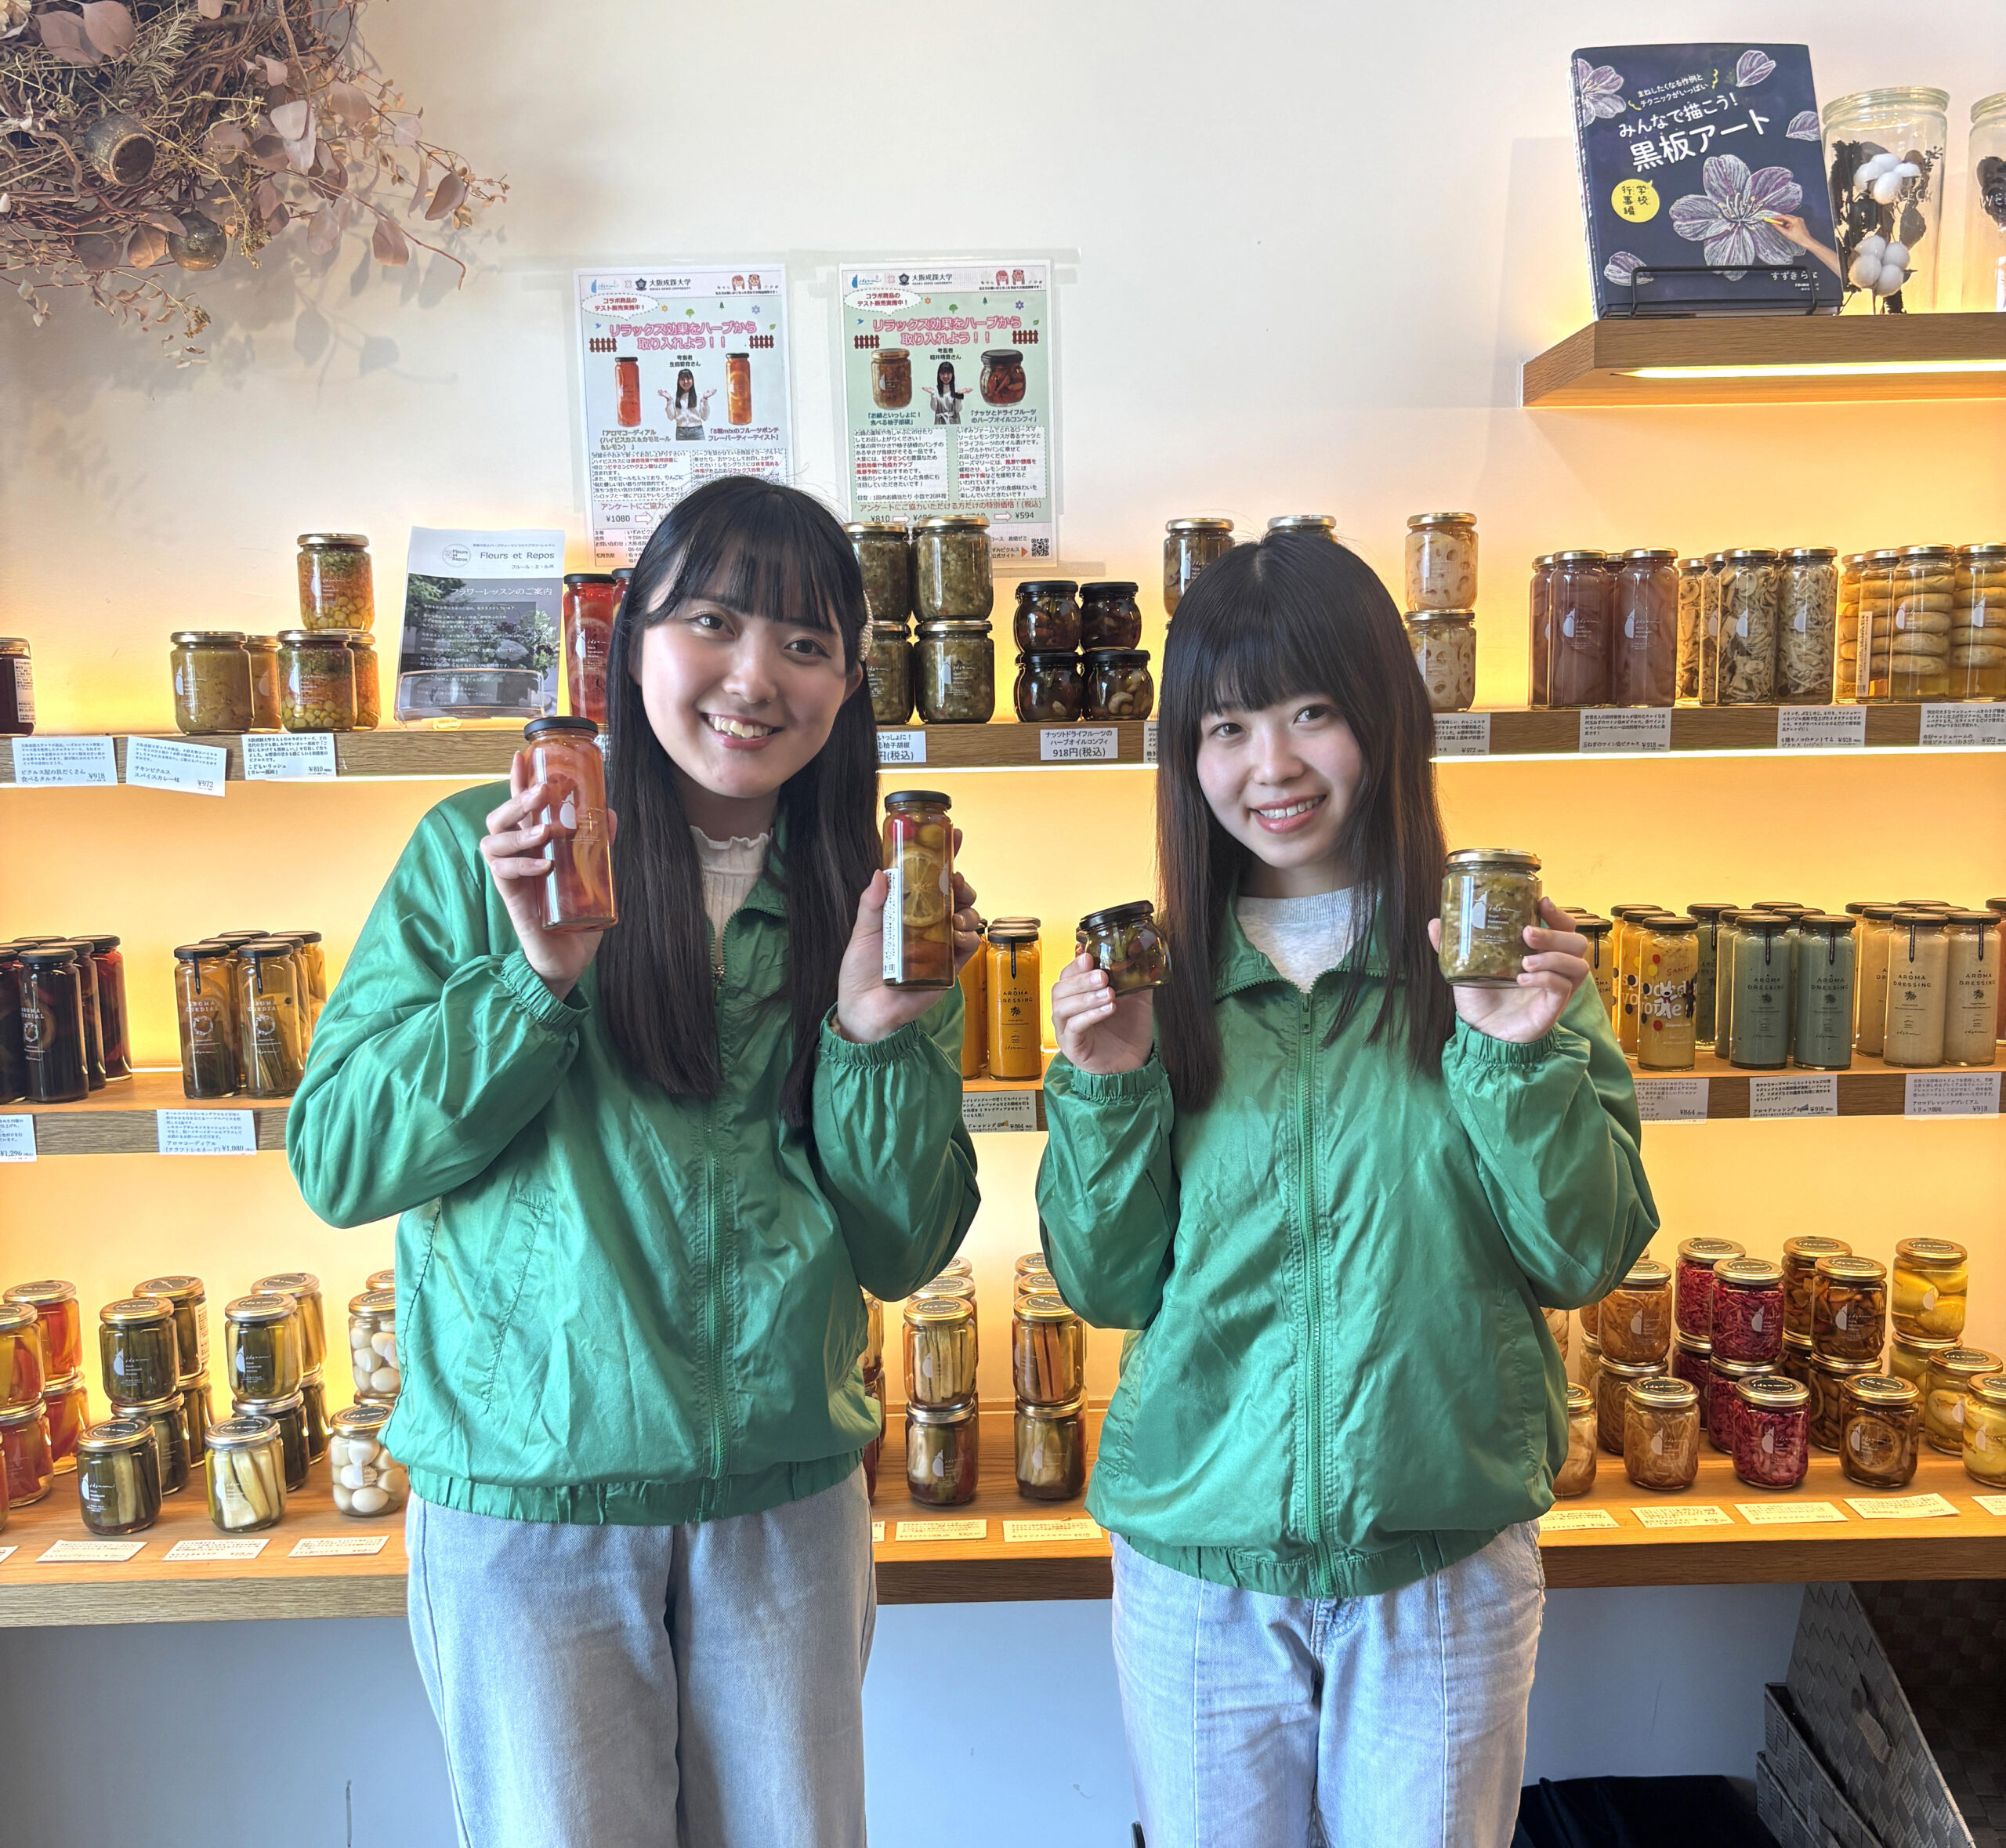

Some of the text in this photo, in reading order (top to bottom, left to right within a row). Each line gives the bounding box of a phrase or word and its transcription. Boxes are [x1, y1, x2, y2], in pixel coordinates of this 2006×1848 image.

[1637, 74, 1704, 98] まねしたくなる作例と
[1640, 84, 1708, 108] テクニックがいっぱい
[1630, 109, 1770, 172] 黒板アート
[1621, 185, 1635, 216] 行事編
[1636, 185, 1649, 205] 学校
[609, 321, 757, 338] リラックス効果をハーブから
[872, 315, 1022, 332] リラックス効果をハーブから
[527, 552, 555, 560] Repos
[451, 587, 552, 596] フラワーレッスンのご案内
[1052, 747, 1106, 758] 918円(税込)
[197, 779, 214, 788] ¥972
